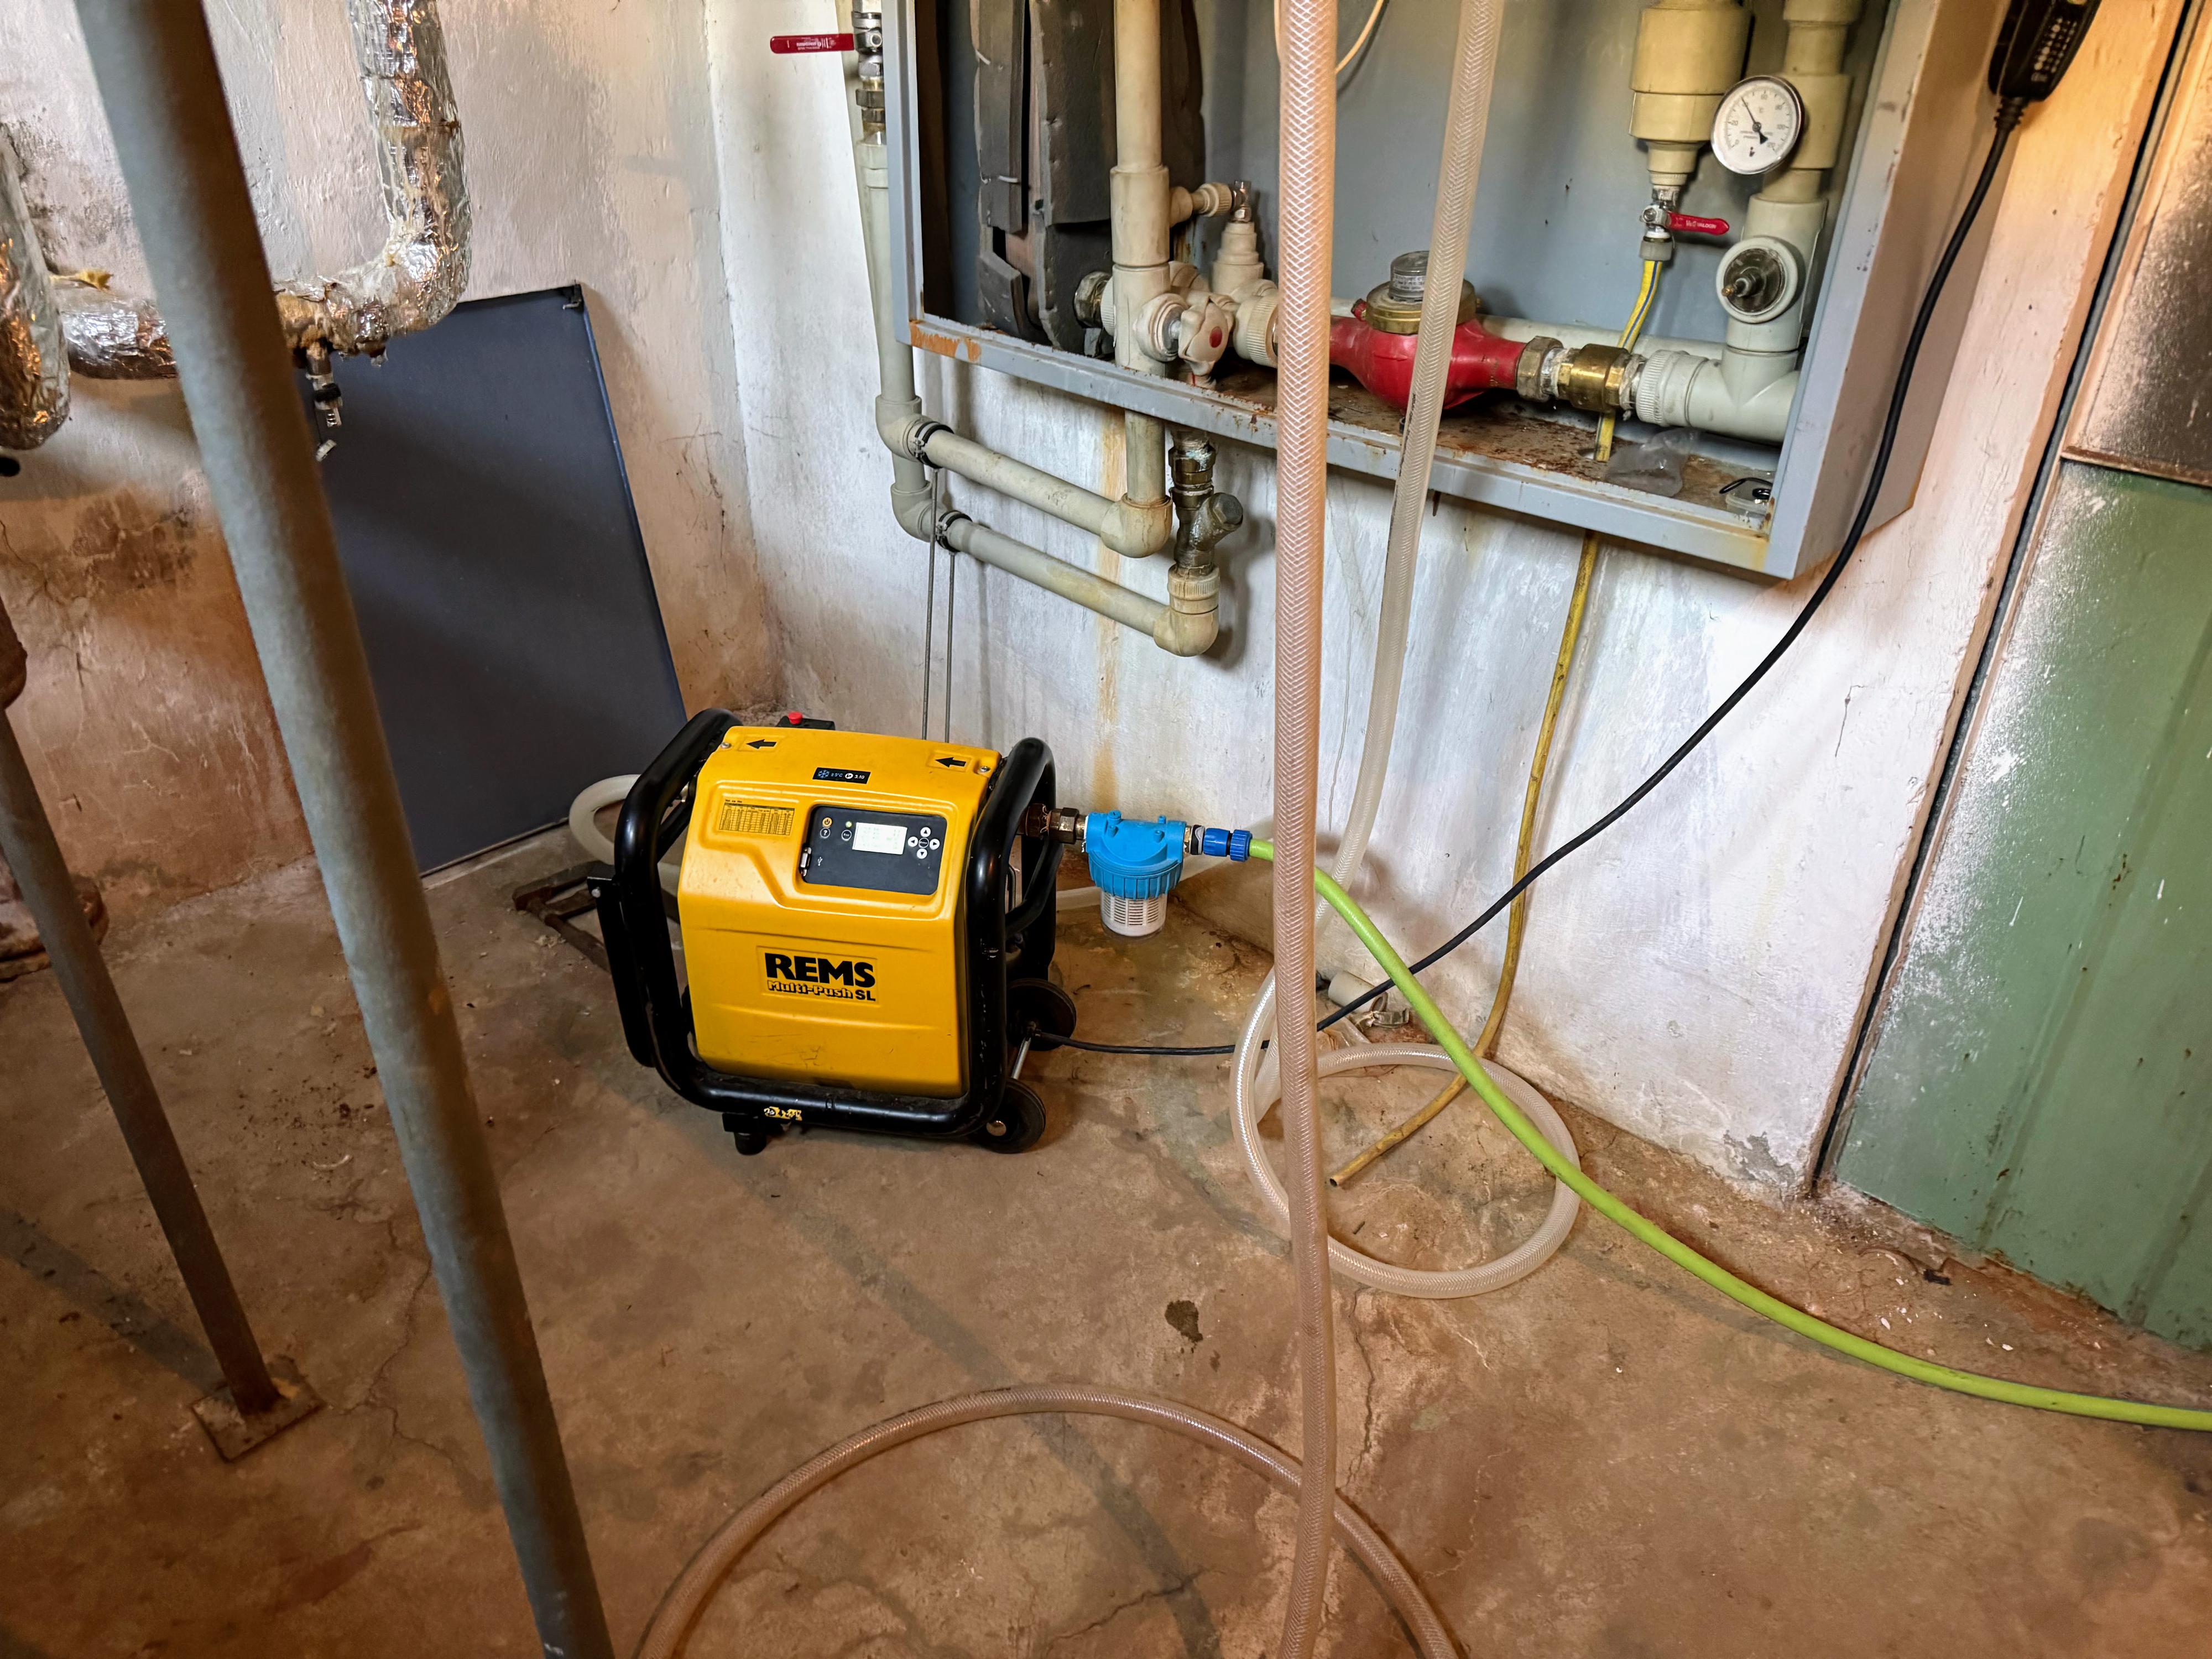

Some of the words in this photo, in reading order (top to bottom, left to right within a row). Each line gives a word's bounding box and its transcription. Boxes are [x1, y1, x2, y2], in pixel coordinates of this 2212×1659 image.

[765, 953, 875, 988] REMS
[767, 980, 853, 999] Multi-Push
[855, 989, 876, 1001] SL
